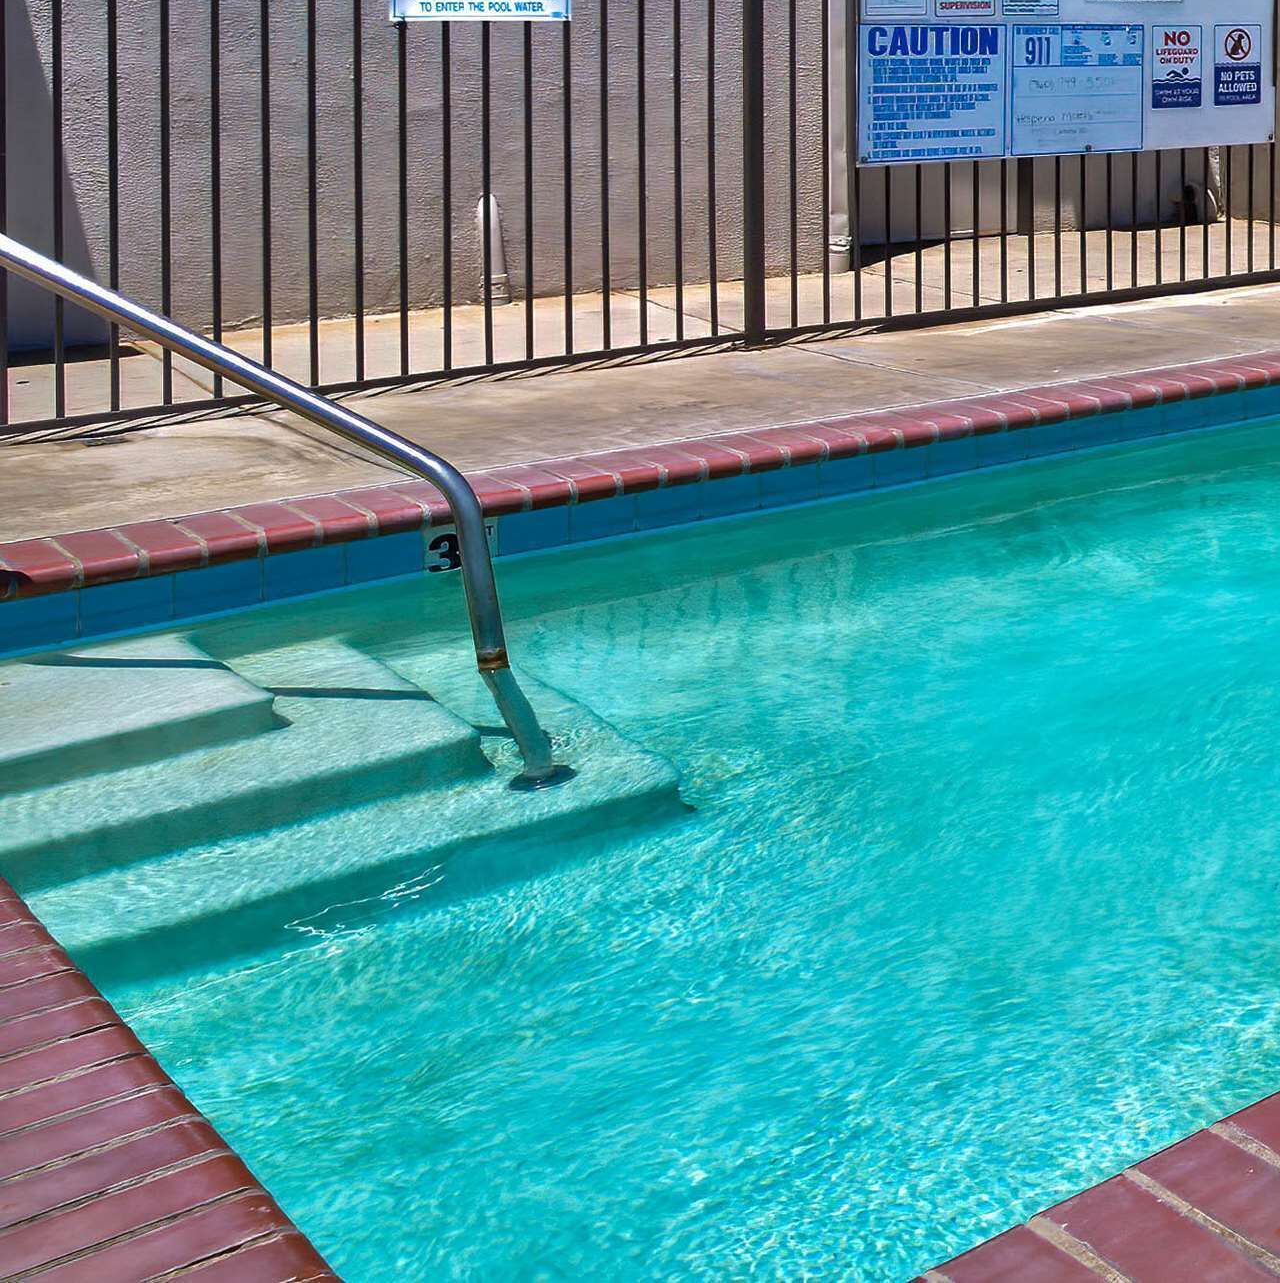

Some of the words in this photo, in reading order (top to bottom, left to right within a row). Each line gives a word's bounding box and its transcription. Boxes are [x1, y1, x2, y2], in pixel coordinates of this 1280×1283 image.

[420, 2, 432, 12] TO
[436, 2, 464, 12] ENTER
[469, 2, 485, 12] THE
[489, 2, 512, 12] POOL
[940, 2, 991, 10] SUPERVISION
[868, 27, 998, 56] CAUTION
[1164, 31, 1191, 46] NO
[1026, 37, 1050, 65] 911
[1156, 48, 1199, 56] LIFEGUARD
[1221, 72, 1232, 81] NO
[1235, 71, 1255, 80] PETS
[1219, 83, 1257, 93] ALLOWED
[428, 533, 463, 572] 3
